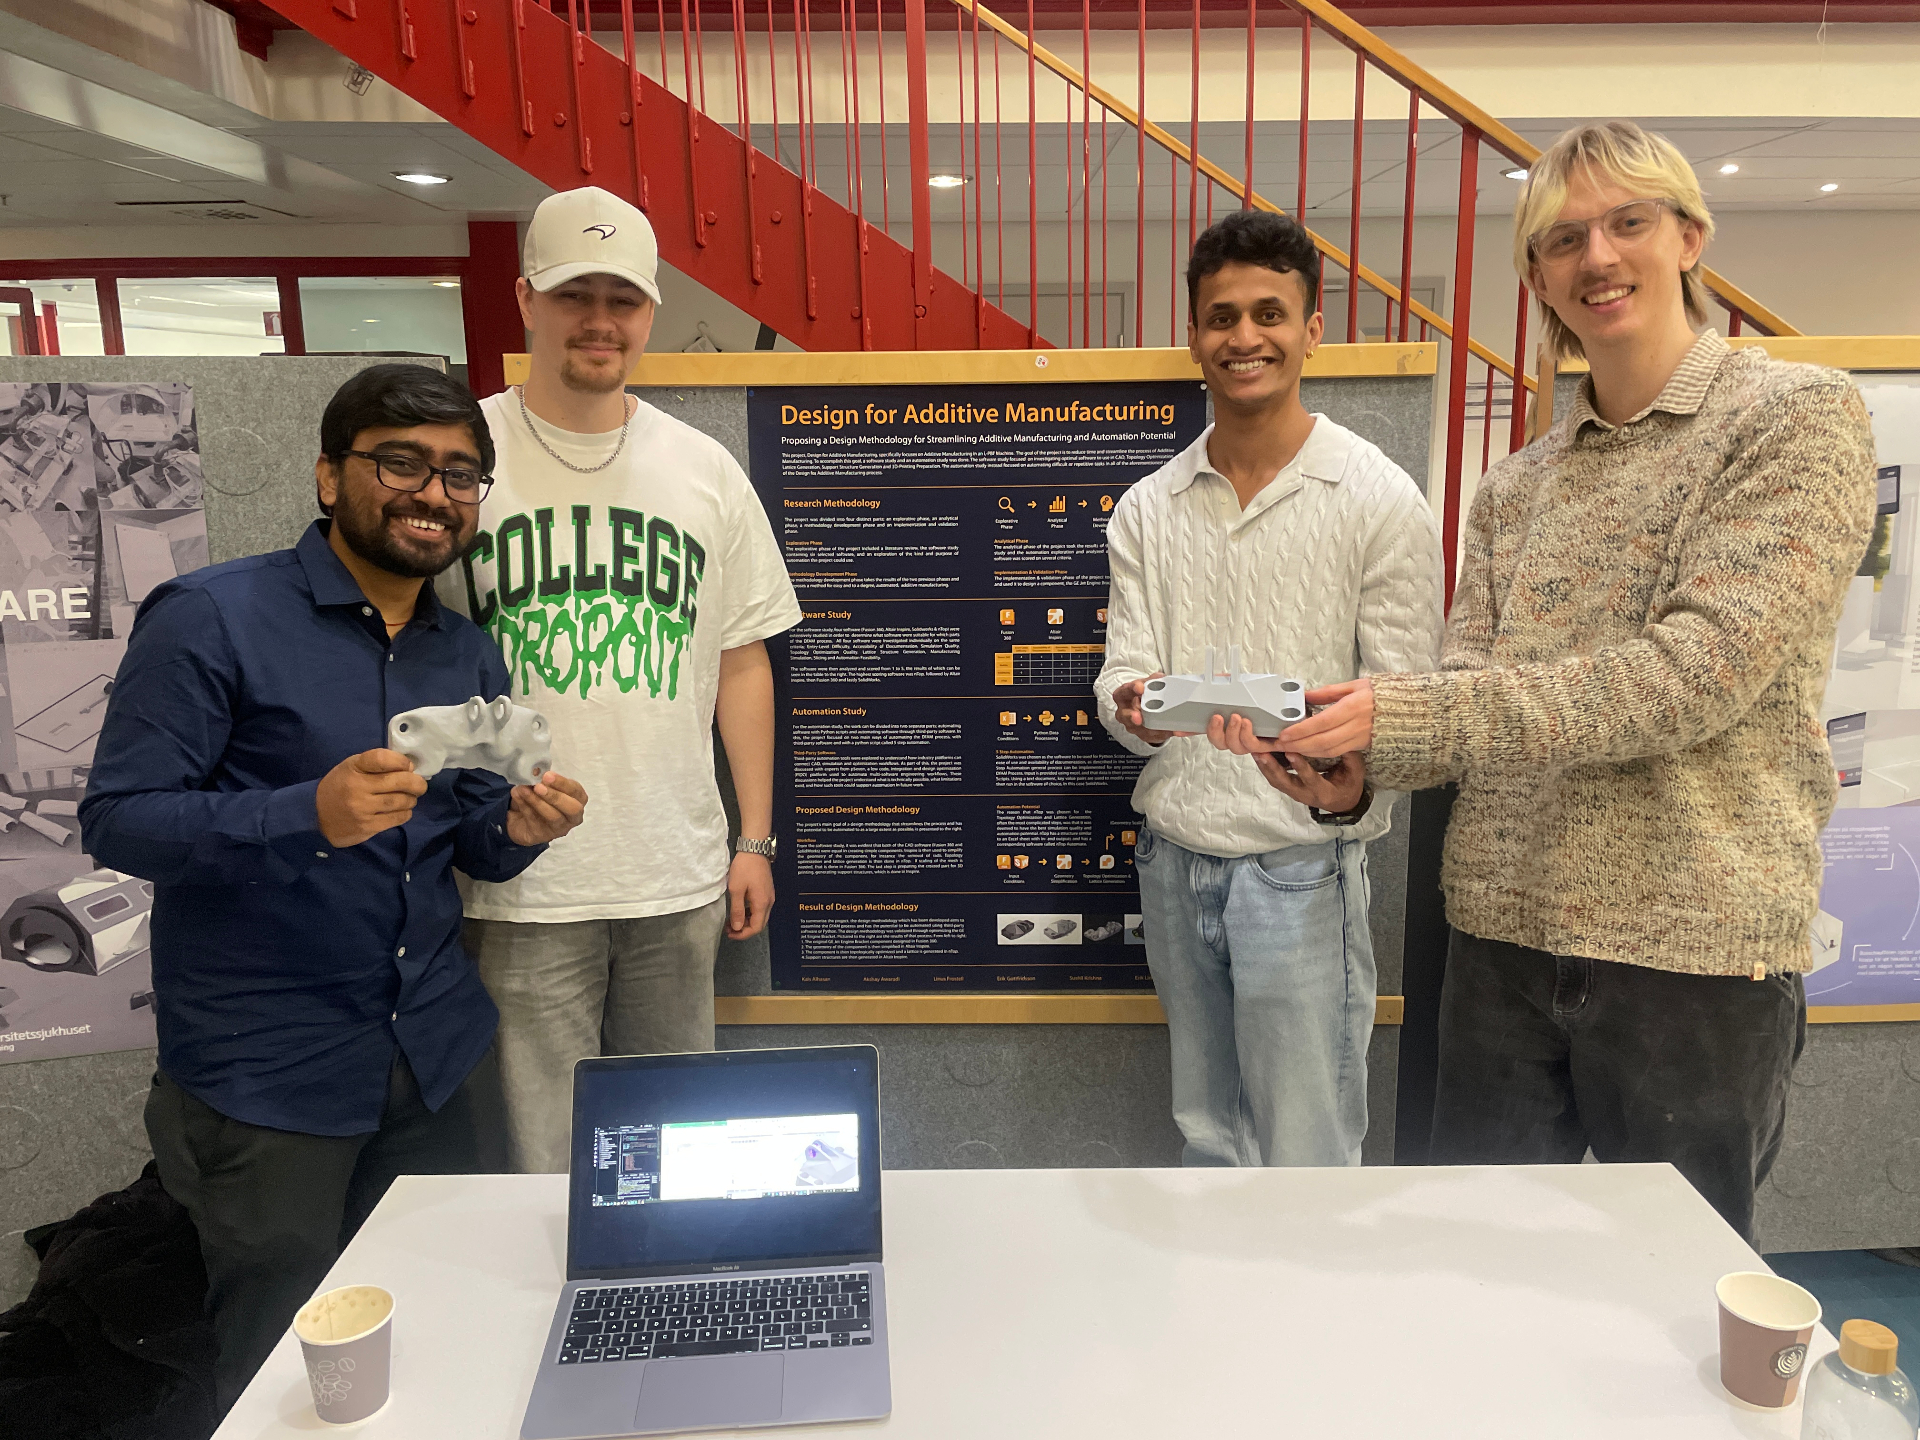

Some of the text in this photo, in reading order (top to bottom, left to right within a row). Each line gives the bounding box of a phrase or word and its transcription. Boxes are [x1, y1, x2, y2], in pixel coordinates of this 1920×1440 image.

[782, 400, 1174, 430] Design for Additive Manufacturing
[781, 436, 821, 446] Proposing
[829, 436, 857, 446] Design
[859, 435, 912, 445] Methodology
[914, 435, 925, 443] for
[927, 435, 977, 445] Streamlining
[979, 434, 1012, 443] Additive
[1014, 433, 1072, 443] Manufacturing
[1074, 433, 1089, 441] and
[1091, 433, 1138, 441] Automation
[1140, 431, 1176, 440] Potential
[784, 499, 880, 509] Research Methodology
[461, 504, 706, 632] COLLEGE
[801, 610, 852, 620] tware Study
[497, 602, 691, 701] DROPOUT
[843, 707, 867, 716] Study
[796, 805, 920, 815] Proposed Design Methodology
[799, 903, 824, 911] Result
[835, 903, 863, 912] Design
[865, 903, 919, 912] Methodology
[0, 1024, 91, 1041] rsitetssjukhuset
[0, 1044, 14, 1052] ing
